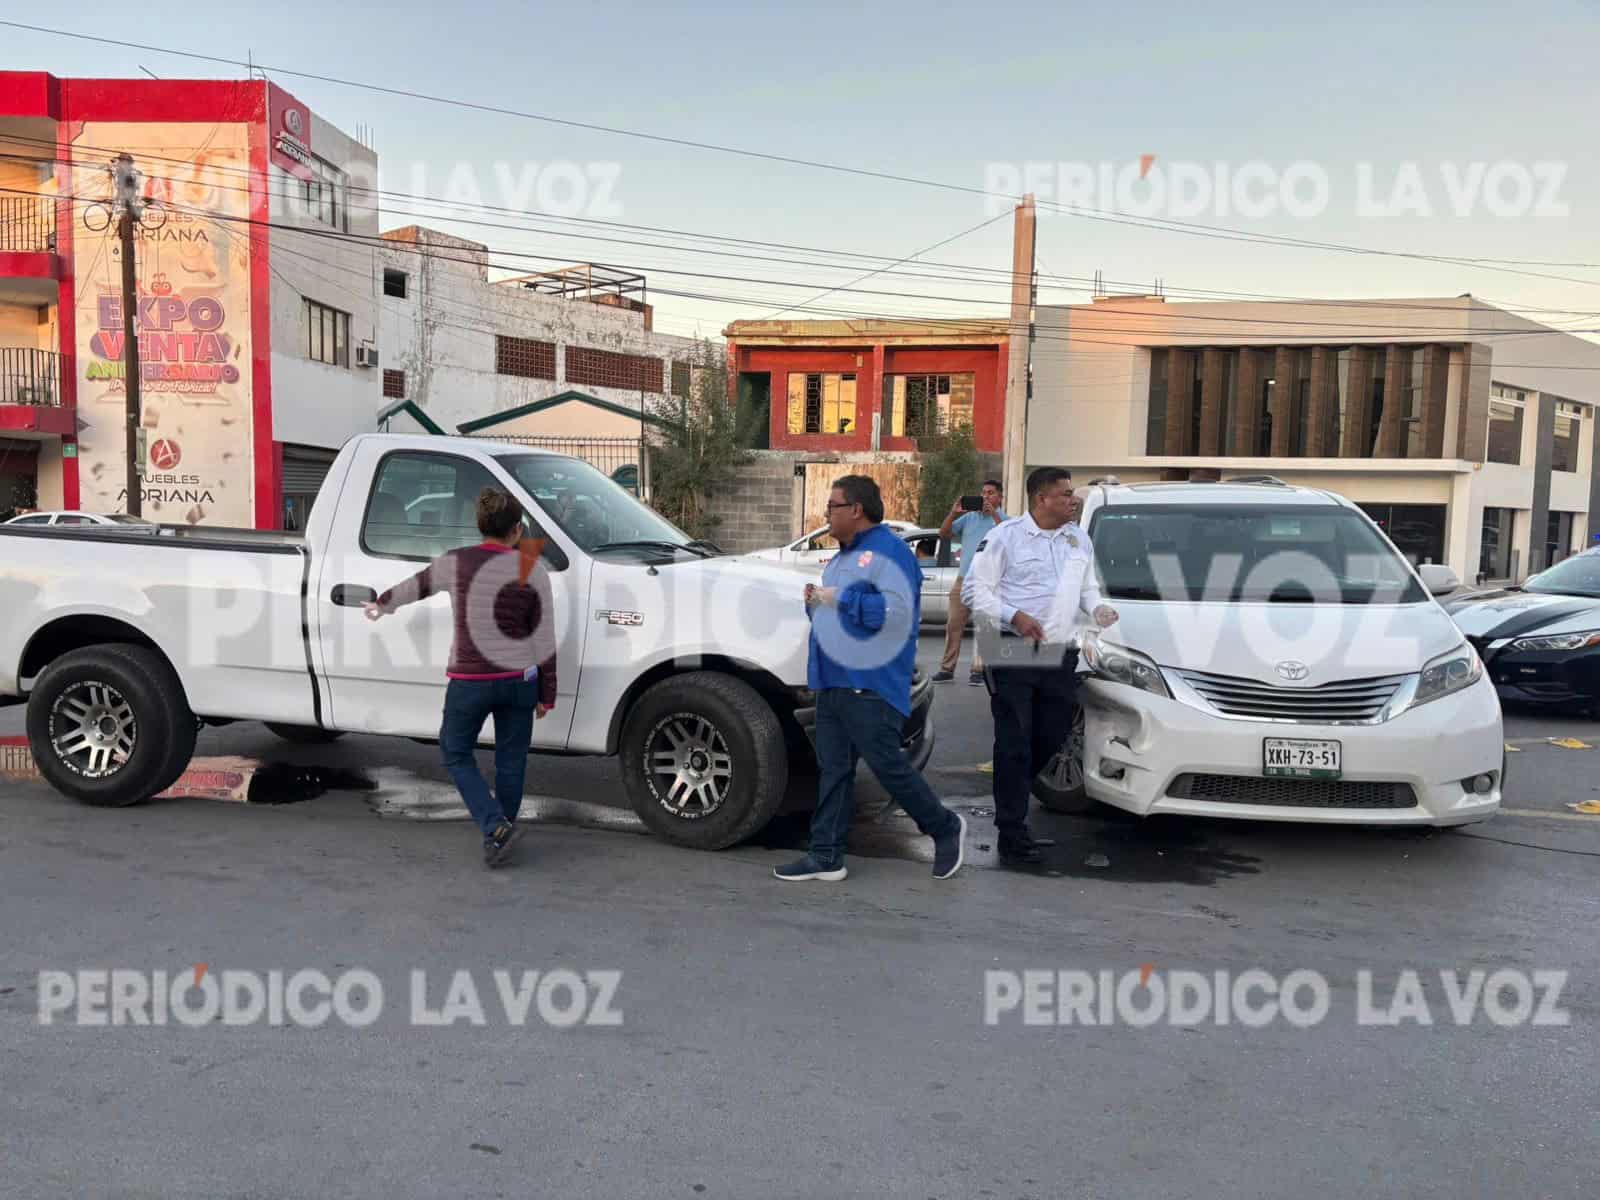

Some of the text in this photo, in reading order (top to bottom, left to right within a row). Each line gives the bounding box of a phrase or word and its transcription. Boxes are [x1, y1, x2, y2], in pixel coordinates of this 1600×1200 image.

[86, 361, 240, 383] ANIERSARIO
[142, 474, 200, 484] UEBLES
[1268, 749, 1336, 766] XKH-73-51
